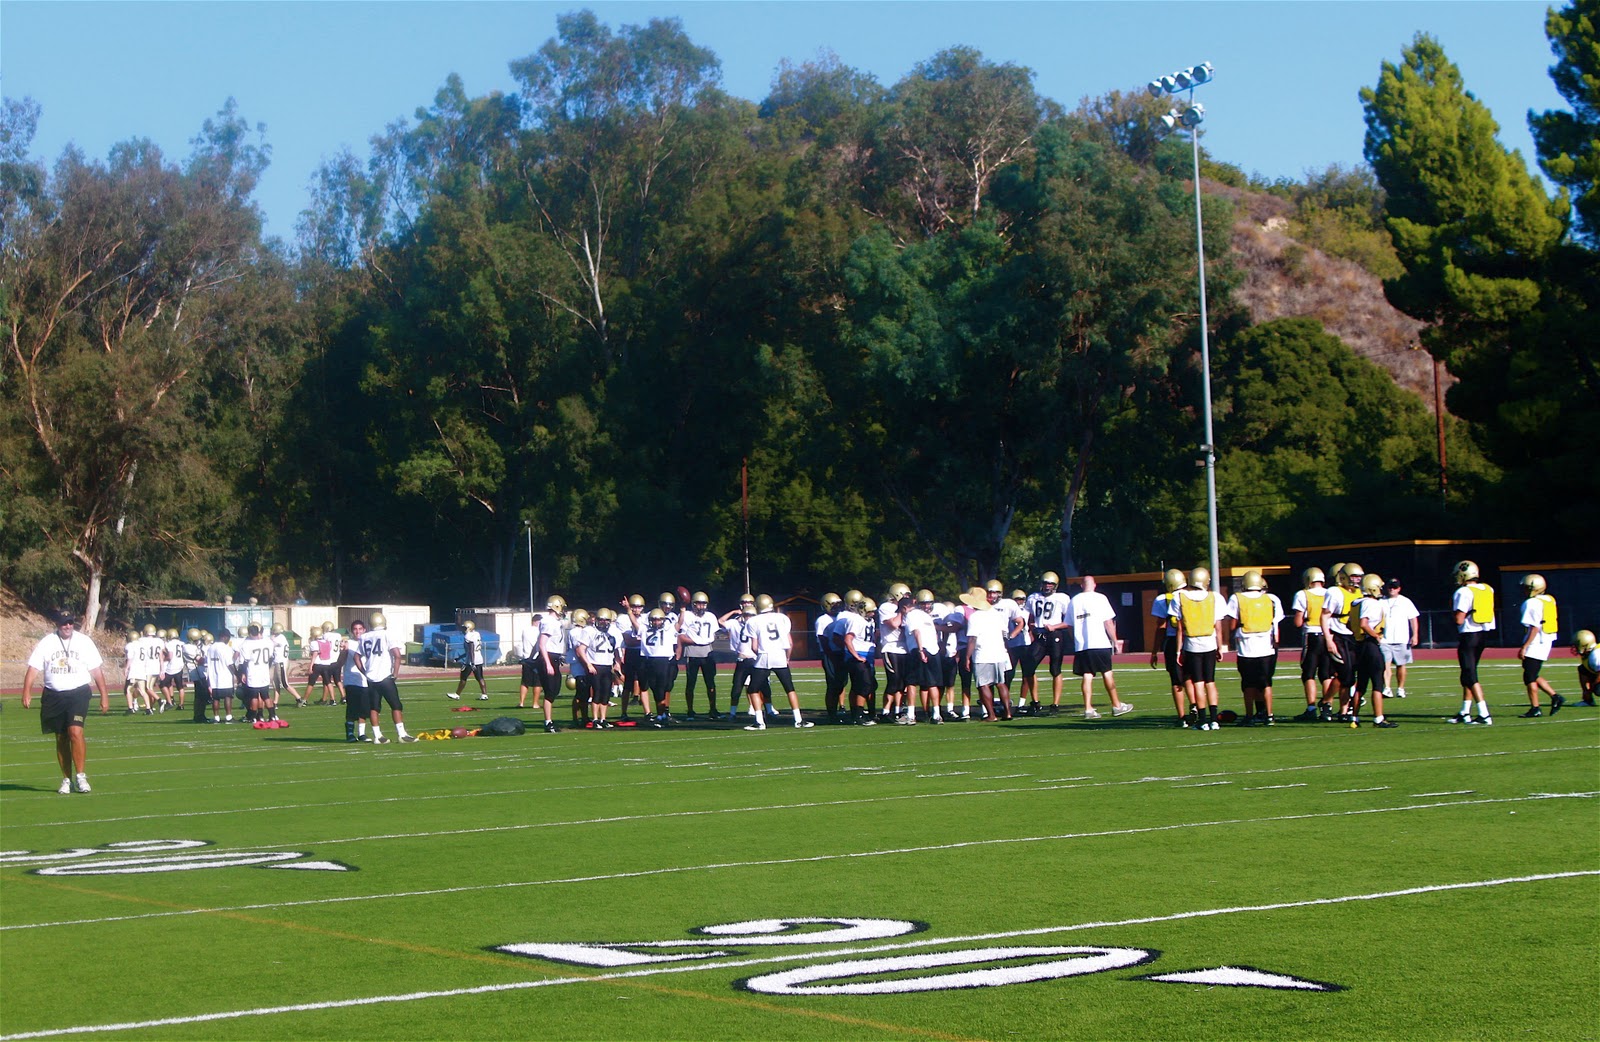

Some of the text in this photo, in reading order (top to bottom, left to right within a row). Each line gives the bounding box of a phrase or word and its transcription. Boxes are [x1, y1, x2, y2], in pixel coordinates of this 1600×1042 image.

[645, 629, 664, 646] 21
[766, 622, 780, 641] 9
[51, 650, 80, 661] COYTE
[252, 647, 270, 666] 70
[363, 638, 383, 660] 64
[50, 666, 78, 674] FOOTBLL
[493, 916, 1159, 995] 20
